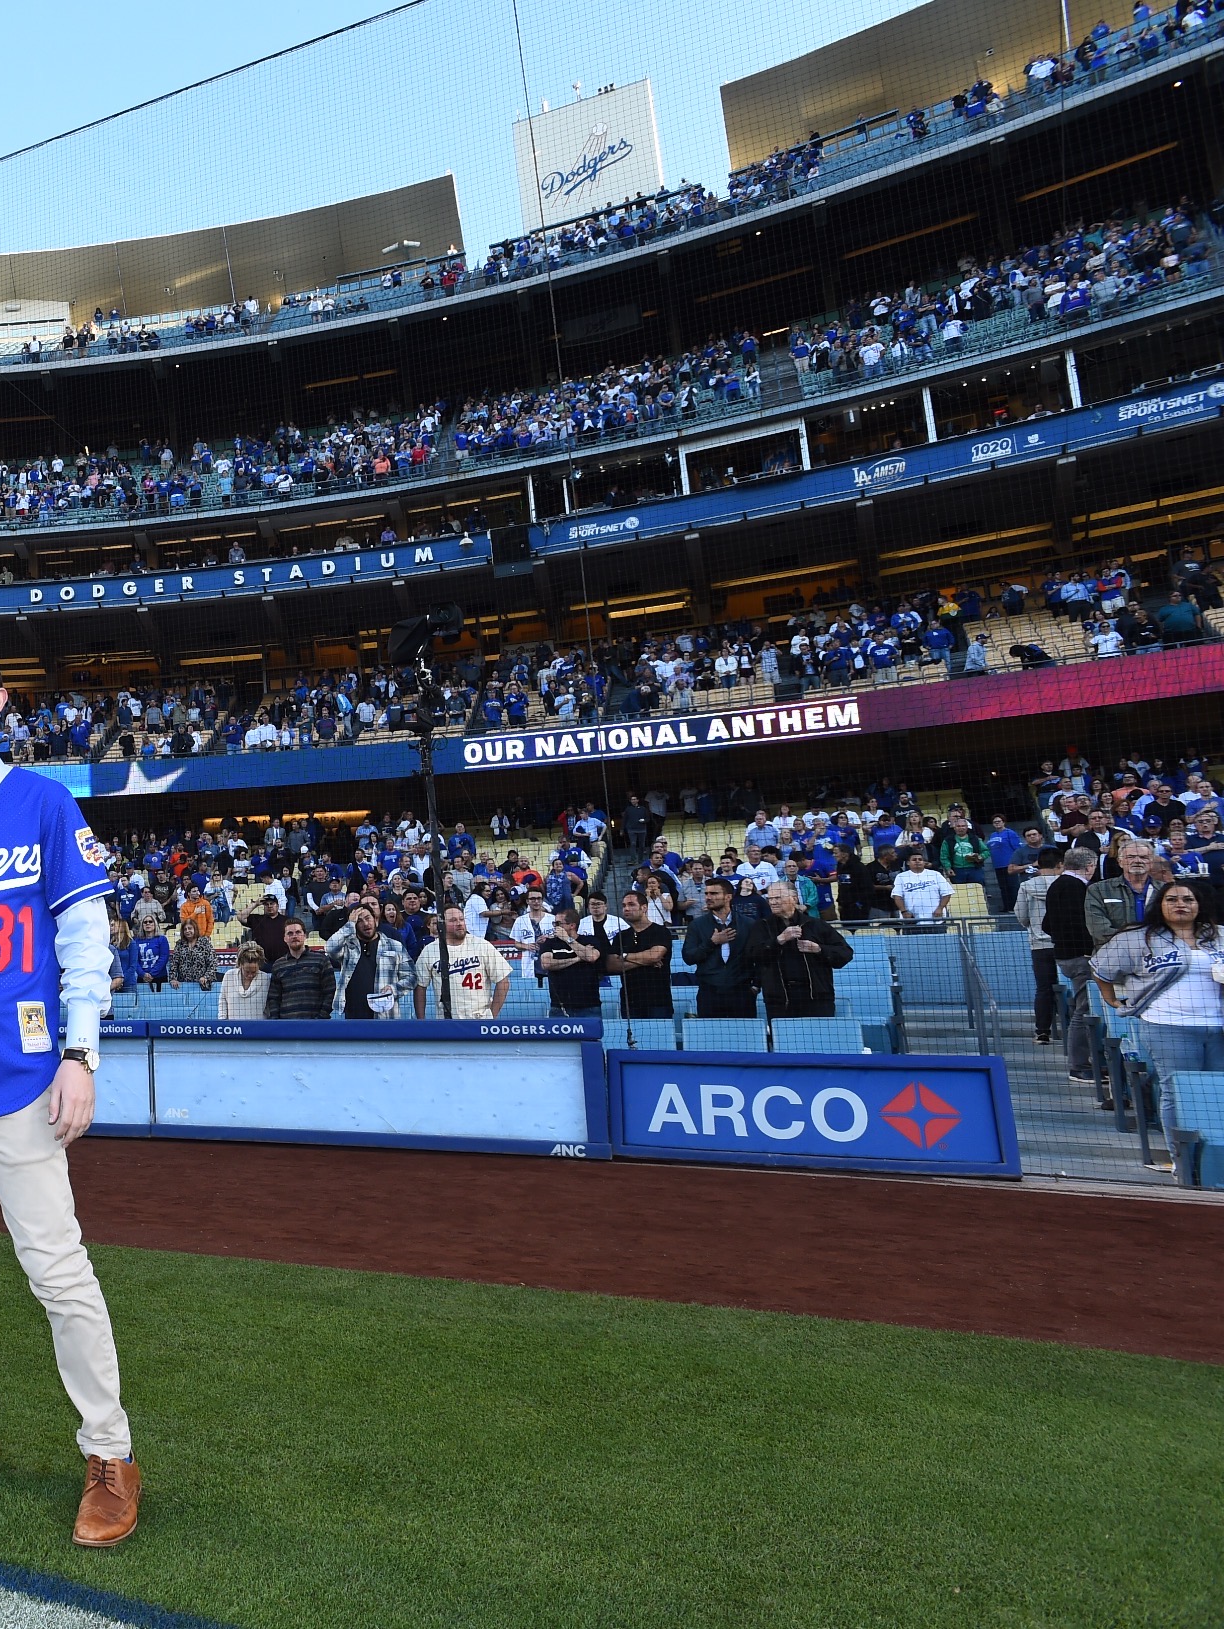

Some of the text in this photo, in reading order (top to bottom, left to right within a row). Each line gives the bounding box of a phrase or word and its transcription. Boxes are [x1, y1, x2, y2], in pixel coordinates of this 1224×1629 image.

[541, 138, 633, 199] Dodgers
[1119, 397, 1161, 412] SPECTRUM
[1119, 391, 1206, 421] SPORTSNET
[972, 439, 1010, 457] 1020
[852, 467, 872, 487] LA
[873, 461, 906, 478] AM570
[569, 522, 626, 539] SPORTSNET
[30, 575, 194, 603] DODGER
[233, 546, 434, 585] STADIUM
[464, 702, 860, 764] OUR NATIONAL ANTHEM
[461, 972, 483, 990] 42
[160, 1025, 243, 1035] DODGERS.COM
[480, 1024, 585, 1035] DODGERS.COM
[164, 1107, 189, 1118] ANC
[648, 1083, 869, 1143] ARCO
[550, 1143, 586, 1157] ANC
